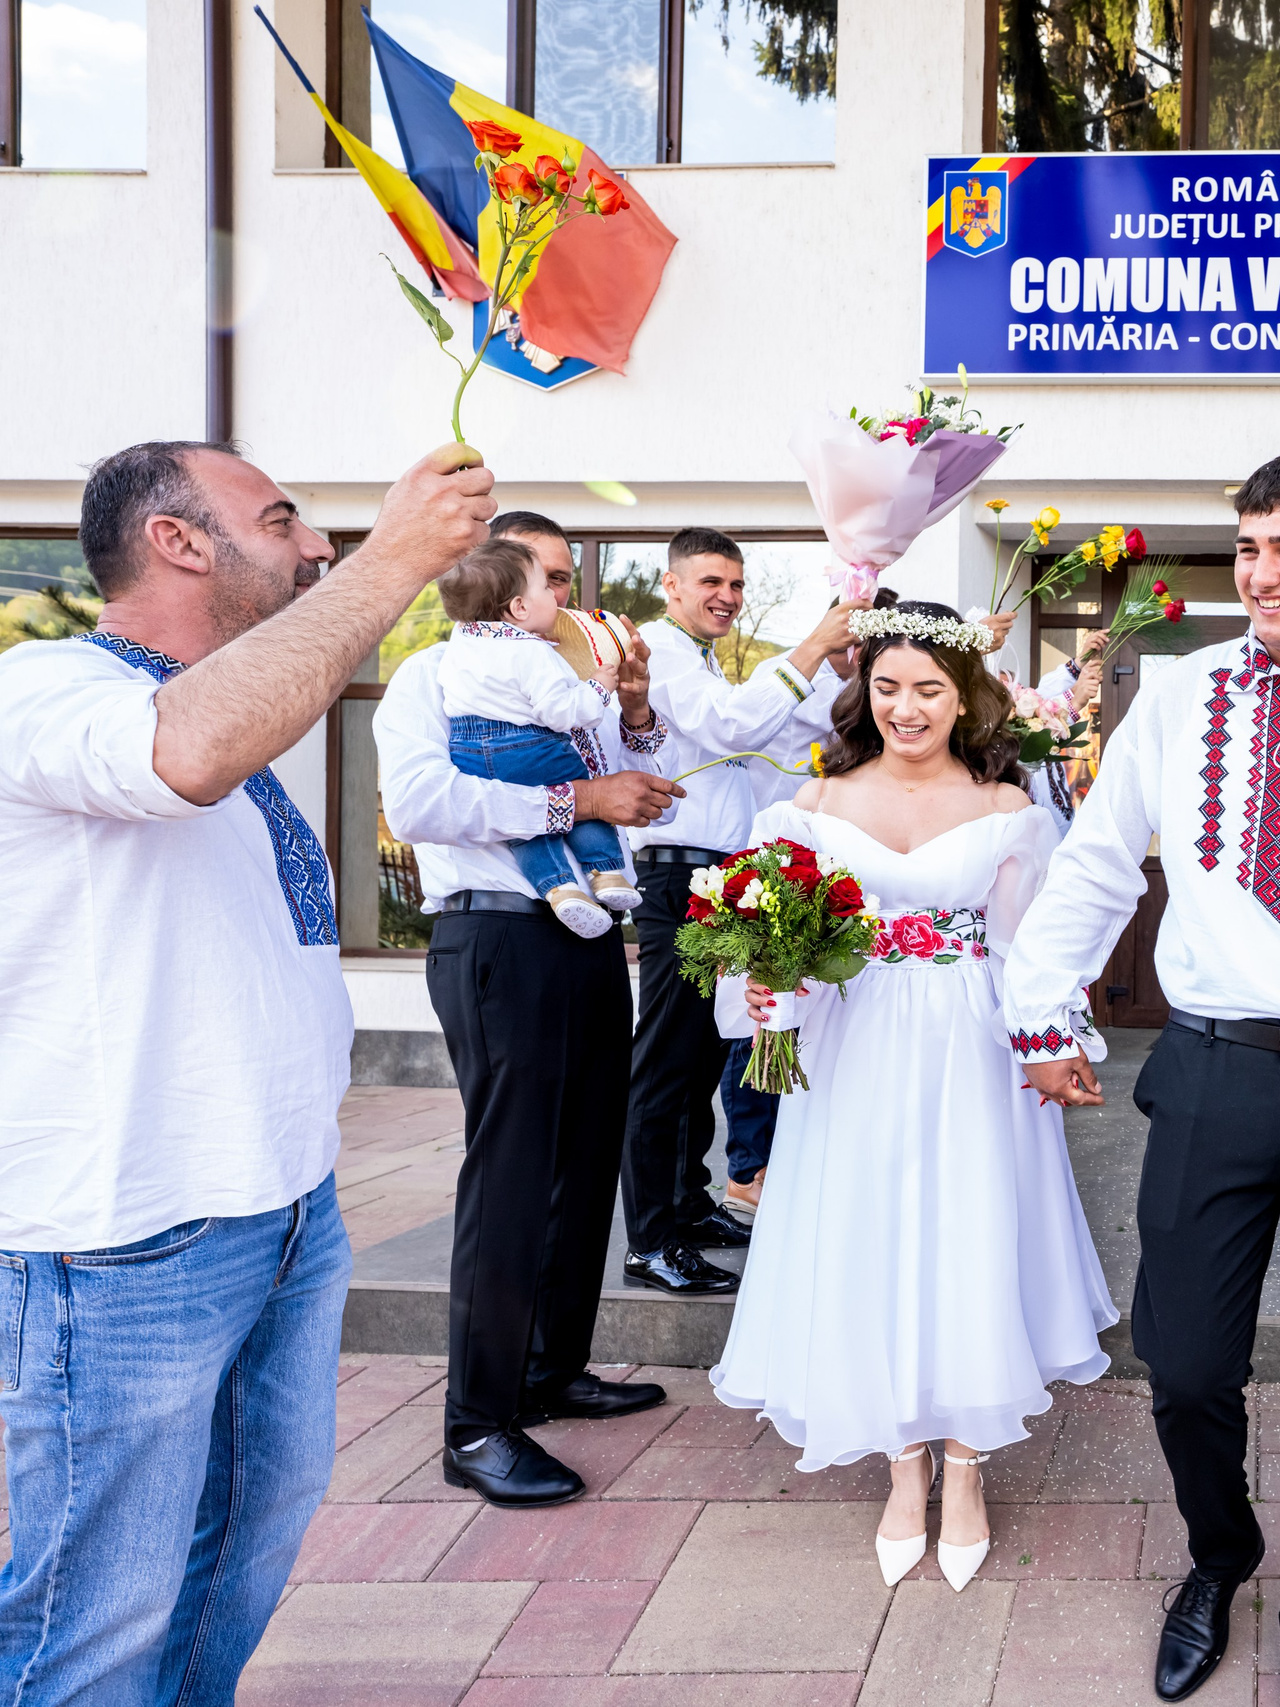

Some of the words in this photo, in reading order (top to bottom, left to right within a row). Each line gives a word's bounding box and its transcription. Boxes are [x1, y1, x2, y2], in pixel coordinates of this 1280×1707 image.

[1109, 212, 1247, 247] JUDEȚUL
[1009, 256, 1237, 314] COMUNA
[1007, 314, 1179, 351] PRIMĂRIA
